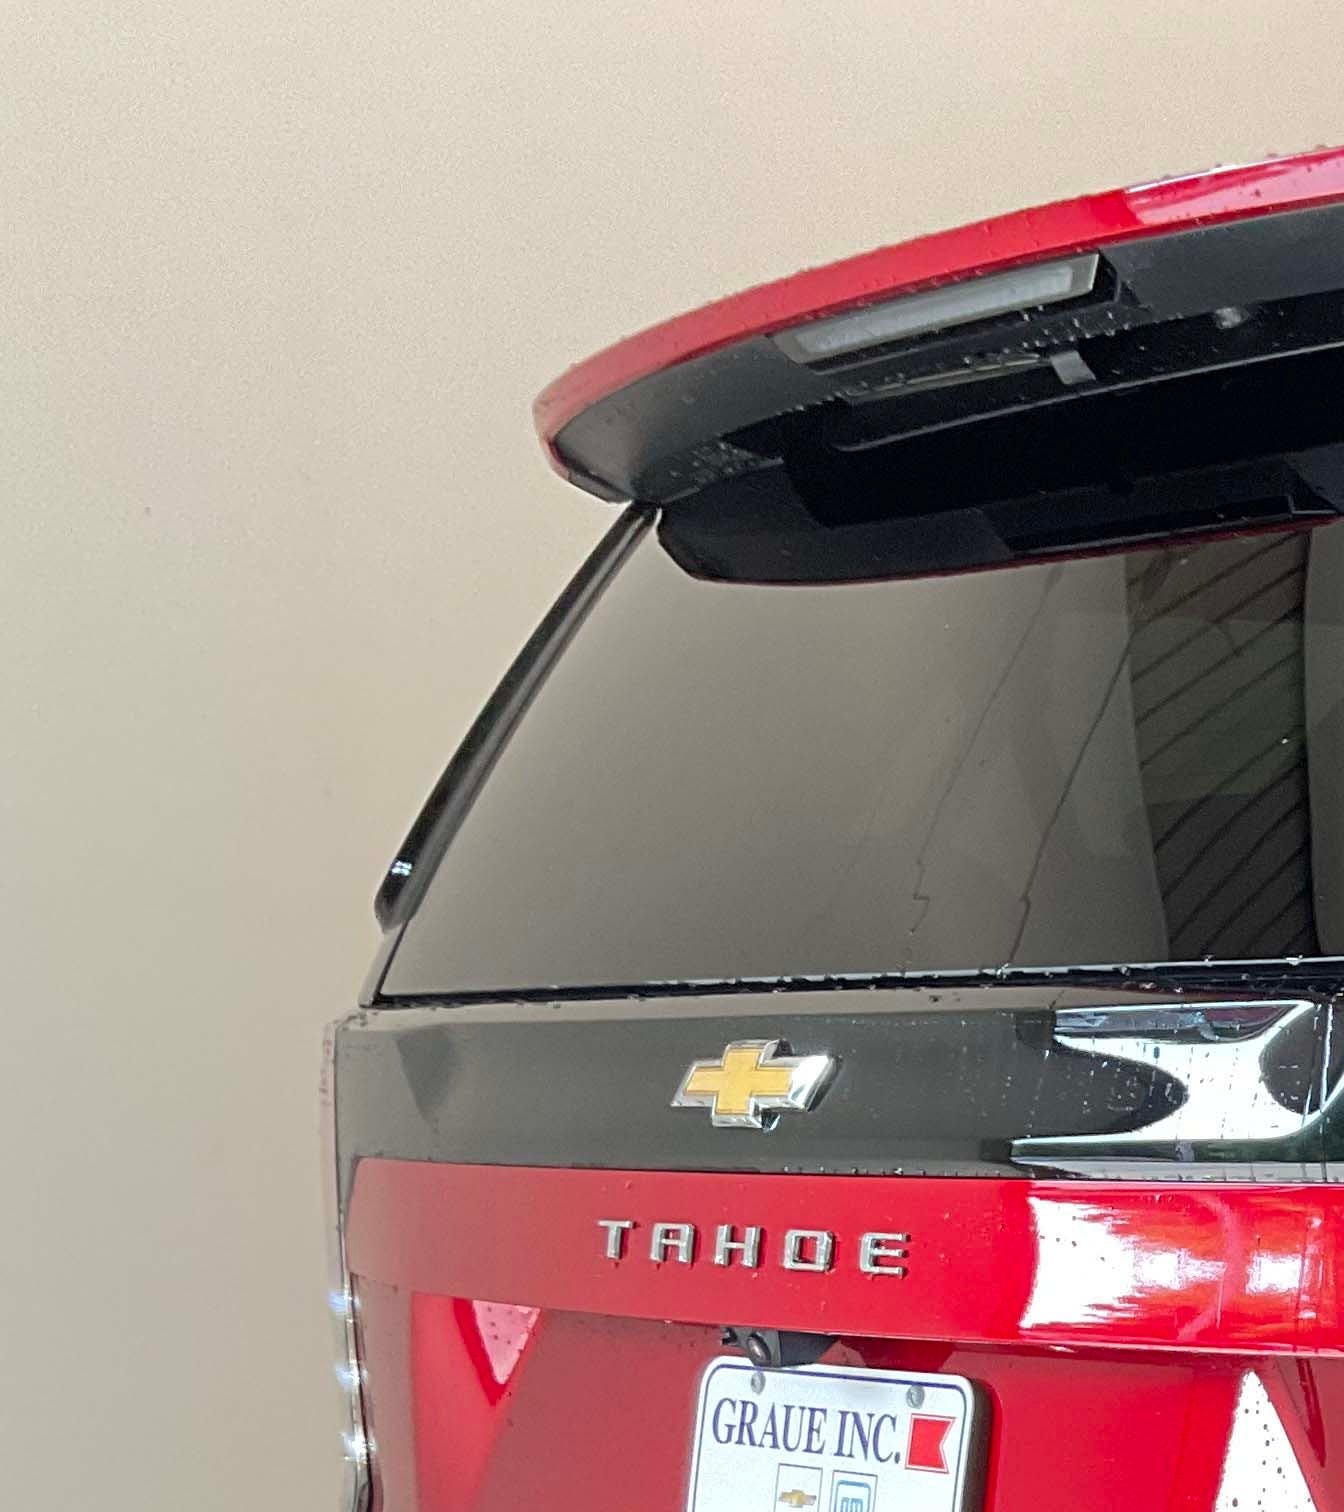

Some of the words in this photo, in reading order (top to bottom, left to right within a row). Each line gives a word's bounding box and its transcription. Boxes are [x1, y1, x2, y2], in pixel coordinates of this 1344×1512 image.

[597, 1219, 911, 1277] TAHOE
[712, 1397, 828, 1455] GRAUE
[833, 1409, 901, 1465] INC.
